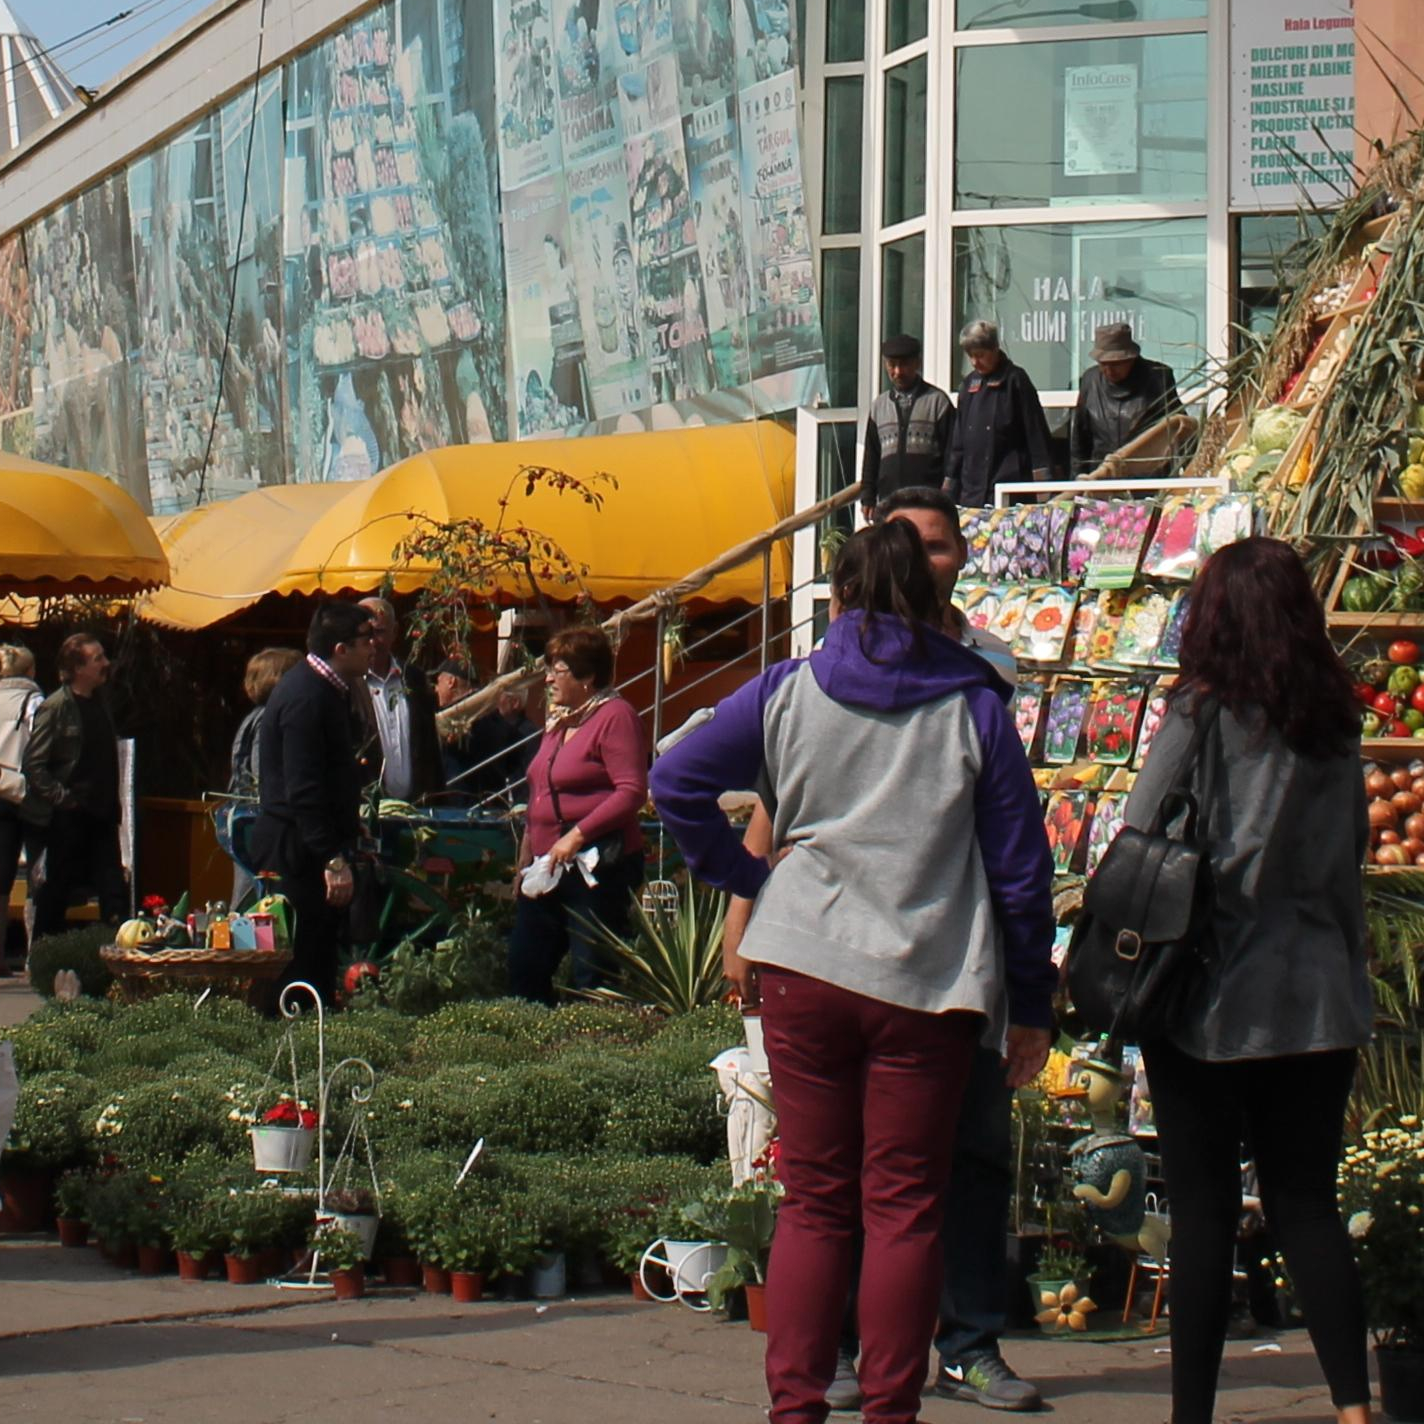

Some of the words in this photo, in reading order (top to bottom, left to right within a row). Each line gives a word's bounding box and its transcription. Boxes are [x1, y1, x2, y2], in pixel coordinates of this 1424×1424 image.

[1284, 18, 1310, 32] Hala
[1251, 46, 1309, 63] DULCIURI
[1312, 44, 1334, 59] DIN
[1251, 64, 1288, 80] MIERE
[1291, 63, 1307, 78] DE
[1309, 61, 1352, 77] ALBINE
[1251, 81, 1305, 97] MASLINE
[1251, 97, 1330, 115] INDUSTRIALE
[1251, 116, 1309, 133] PRODUSE
[1311, 152, 1327, 166] DE
